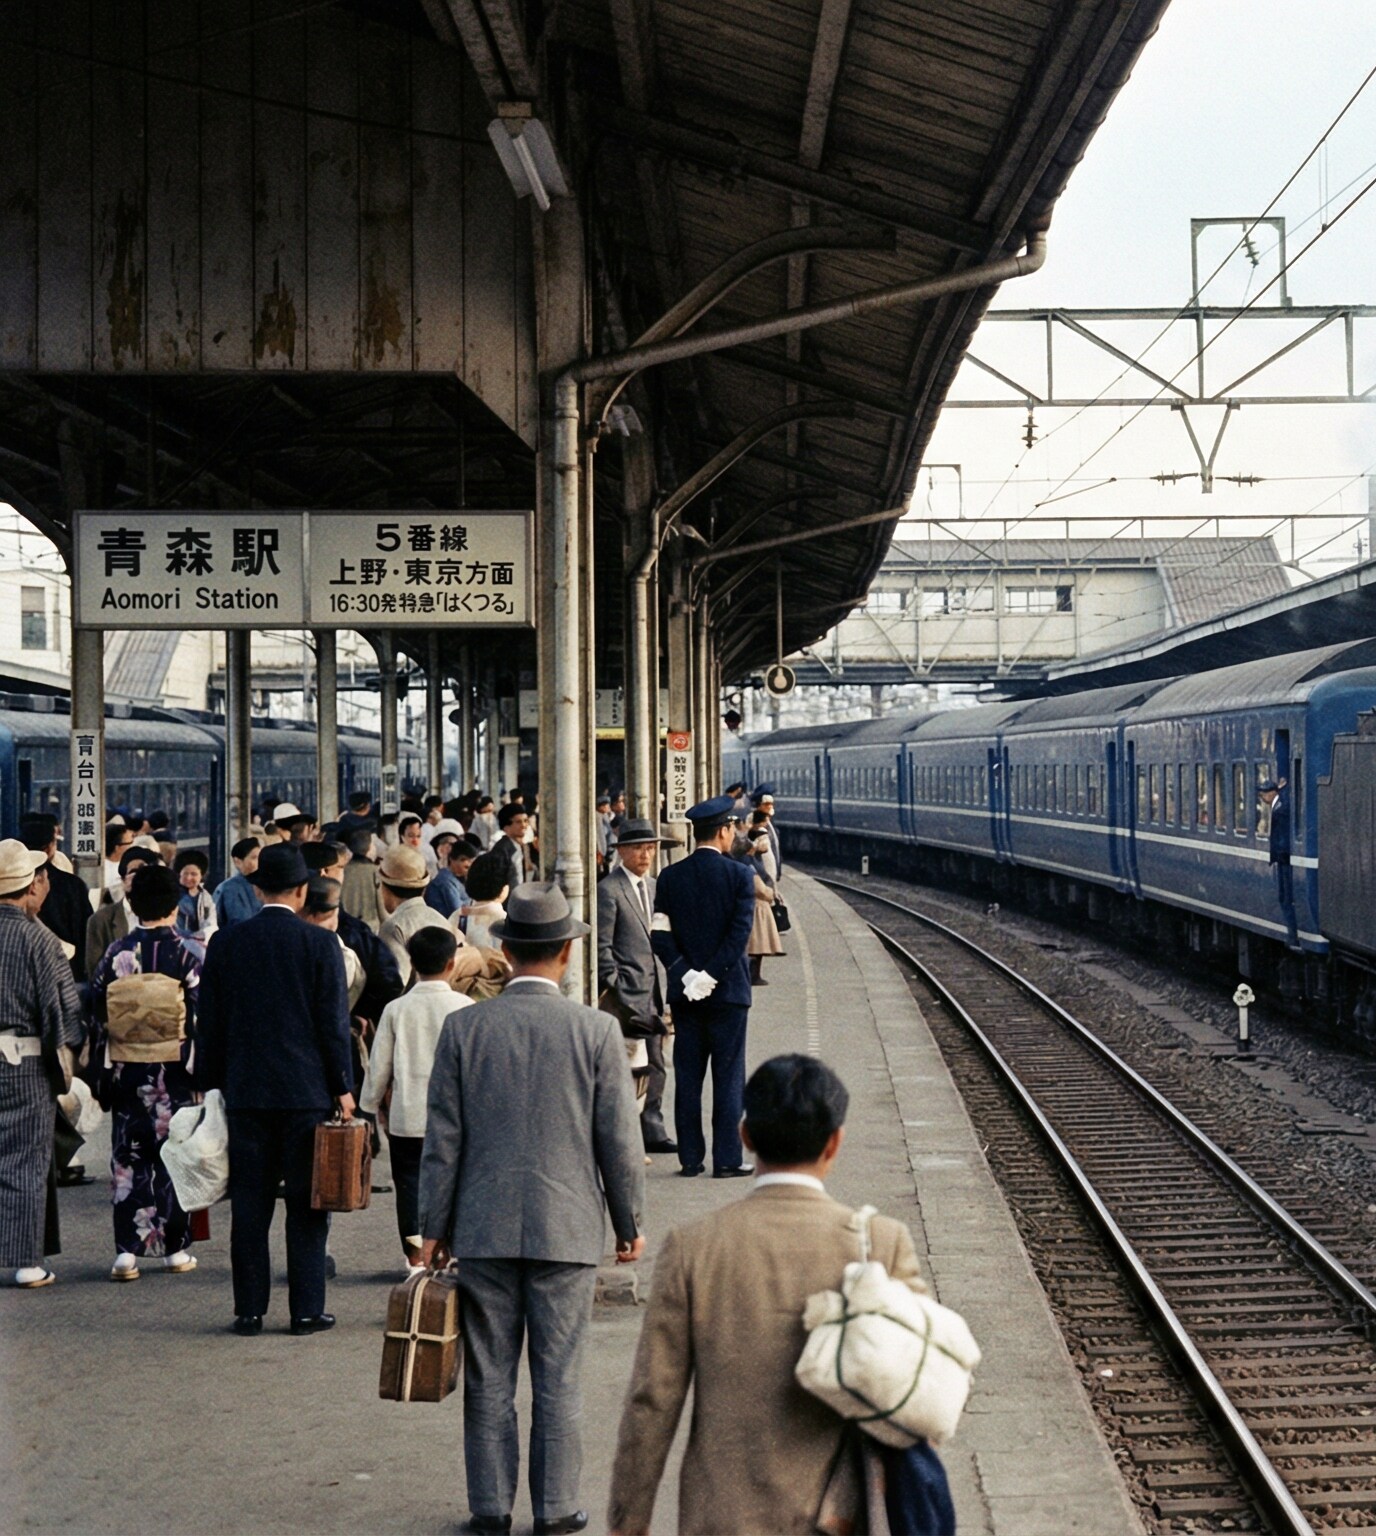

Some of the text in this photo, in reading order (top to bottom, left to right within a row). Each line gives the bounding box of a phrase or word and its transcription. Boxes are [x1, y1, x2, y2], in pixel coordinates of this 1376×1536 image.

[375, 523, 468, 552] 5番線
[97, 527, 281, 577] 青森駅
[329, 557, 515, 585] 上野・東京方面
[101, 587, 279, 609] Aomori Station
